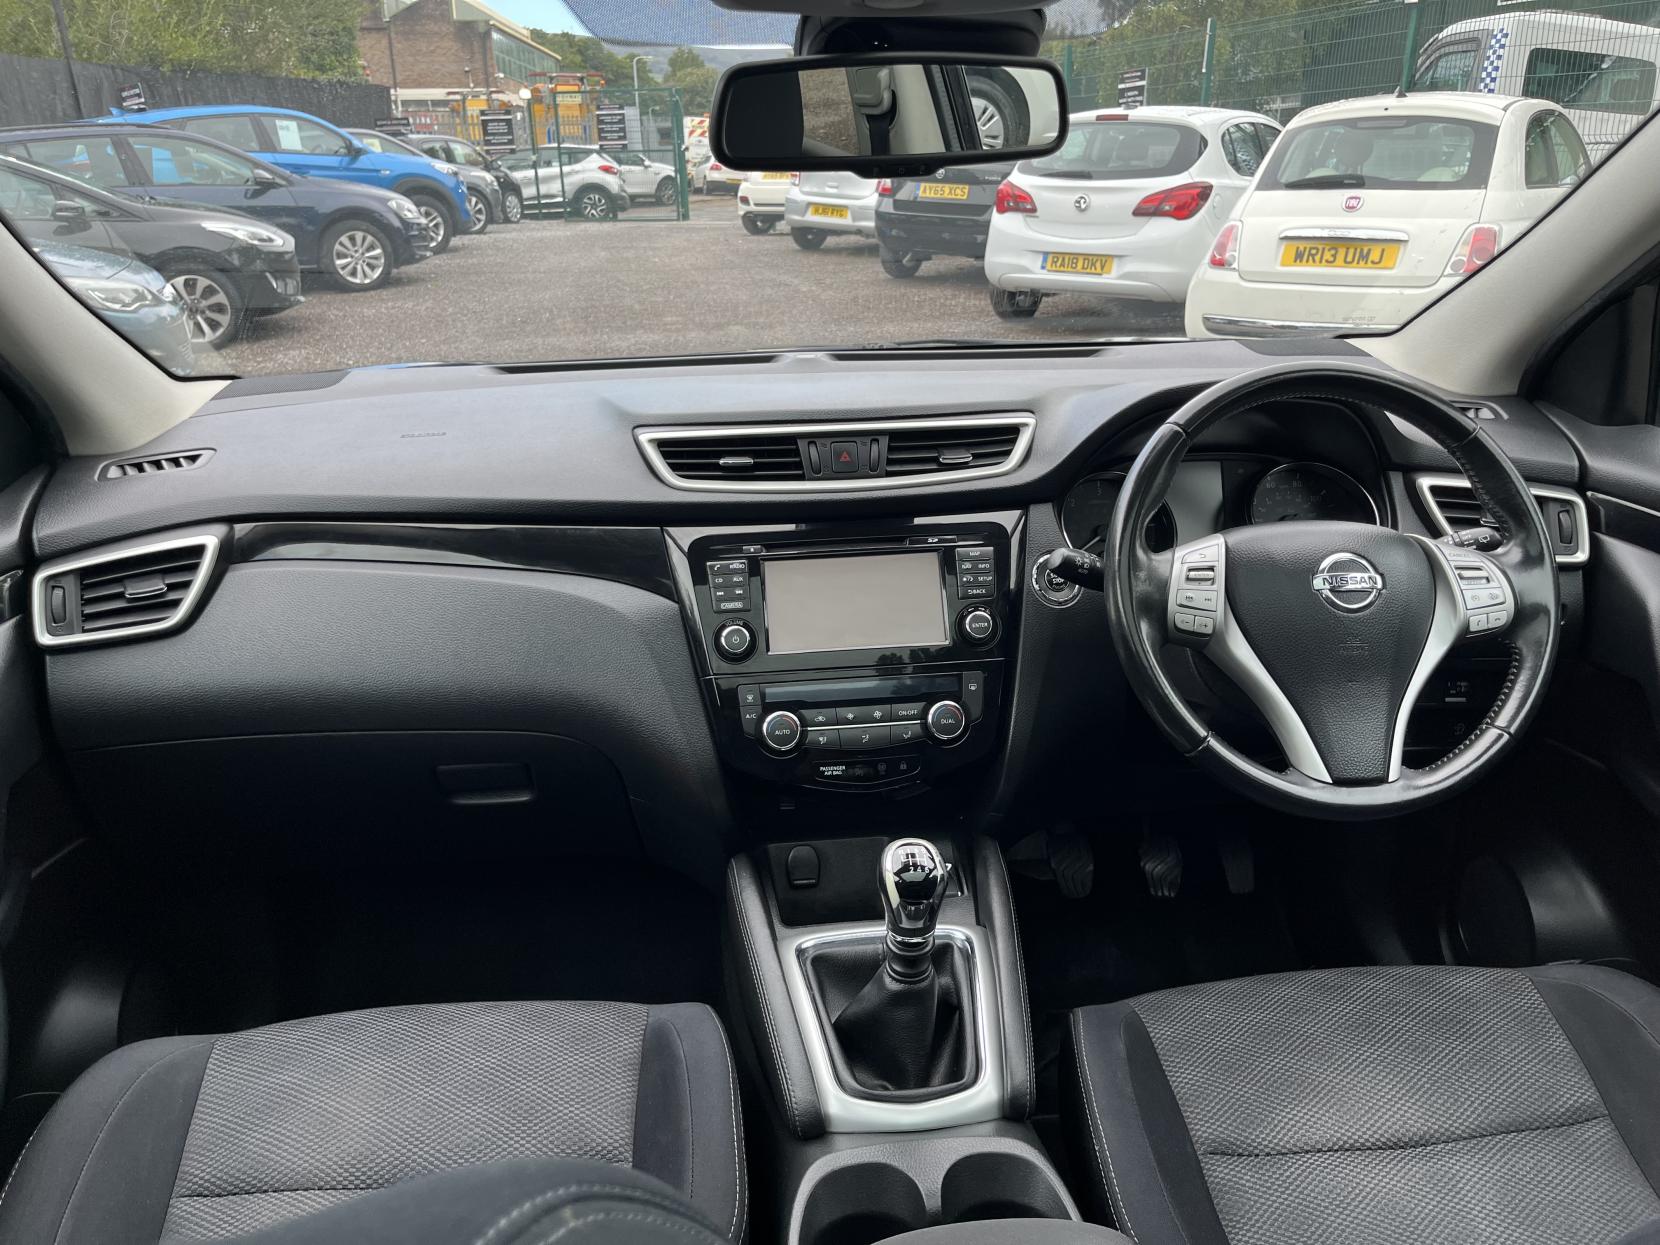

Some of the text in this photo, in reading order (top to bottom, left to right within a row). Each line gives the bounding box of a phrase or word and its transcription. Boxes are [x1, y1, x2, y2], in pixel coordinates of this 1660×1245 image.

[921, 184, 967, 197] AY65 XCS
[1293, 246, 1386, 265] WR13 UMJ
[1050, 256, 1110, 272] RA18 DKV
[1322, 576, 1378, 586] NISSAN
